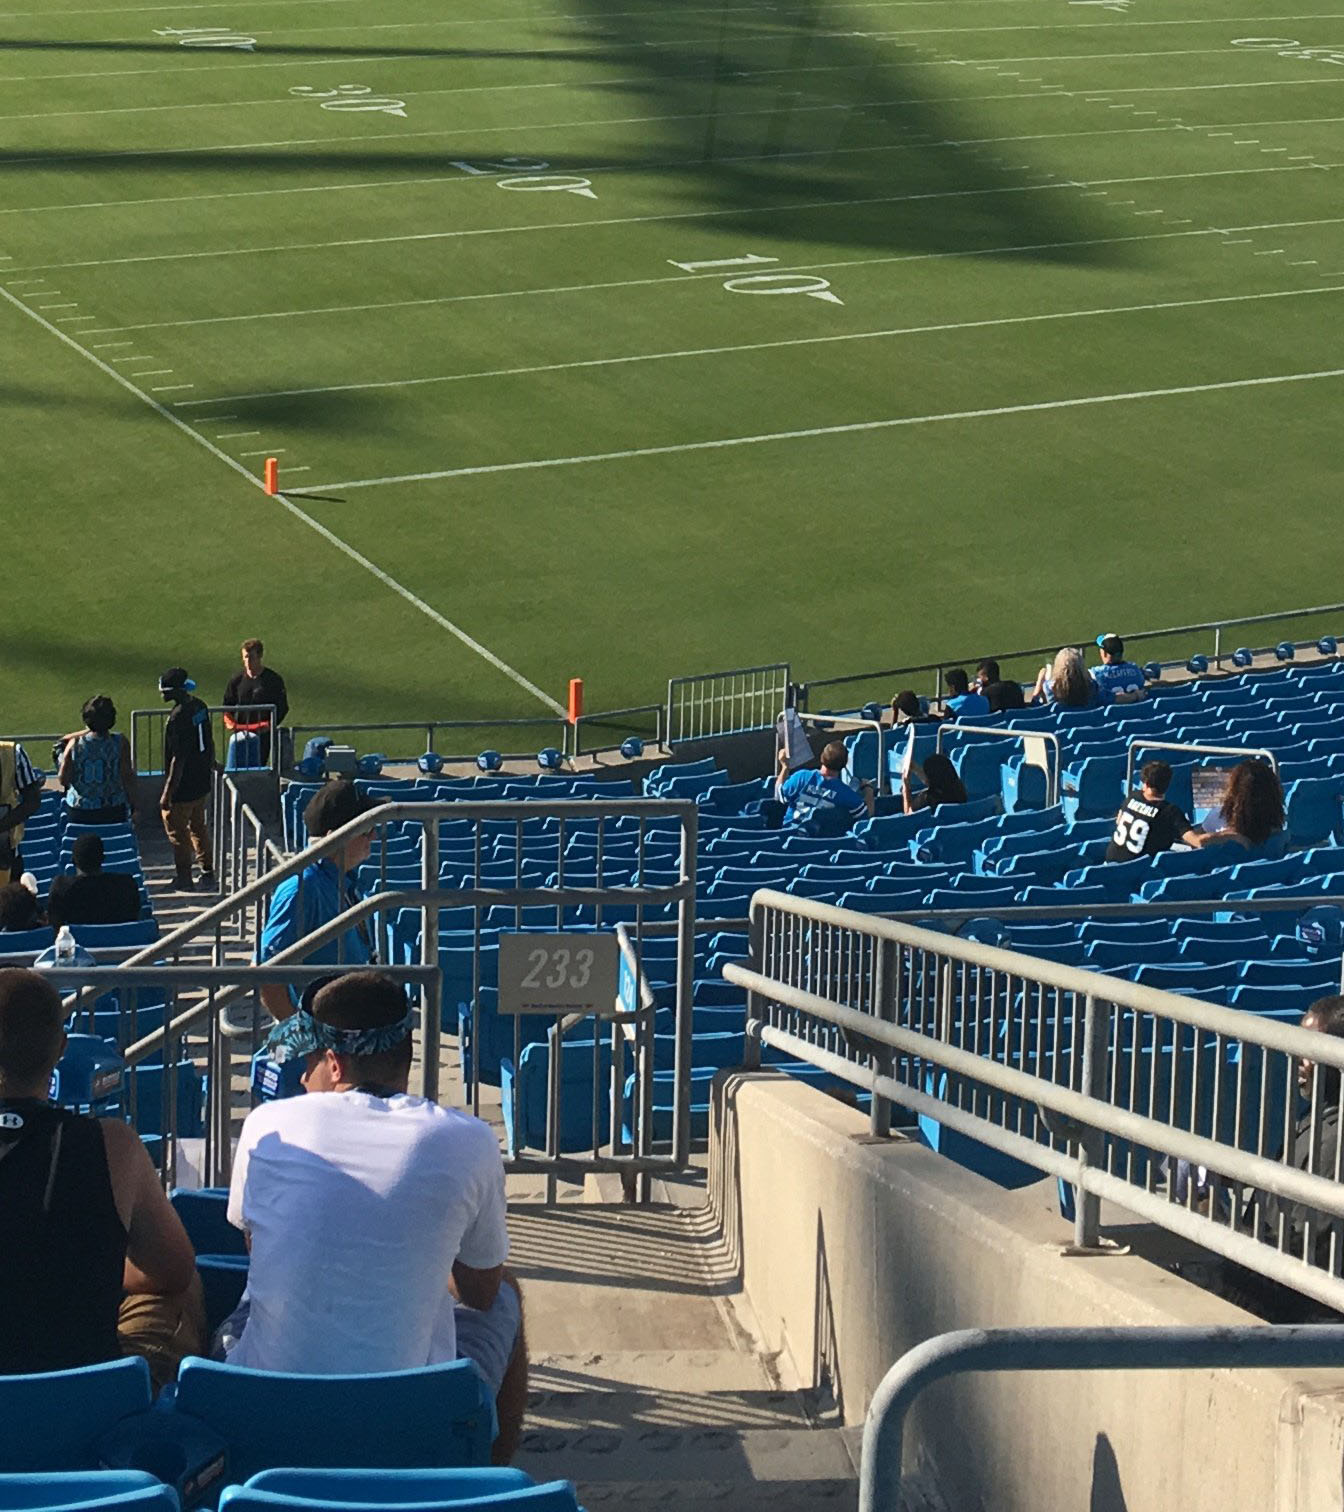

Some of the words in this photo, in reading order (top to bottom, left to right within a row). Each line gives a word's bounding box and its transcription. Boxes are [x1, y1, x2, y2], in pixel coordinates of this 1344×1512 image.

[667, 253, 831, 294] 10
[1113, 810, 1150, 855] 59
[520, 948, 595, 989] 233
